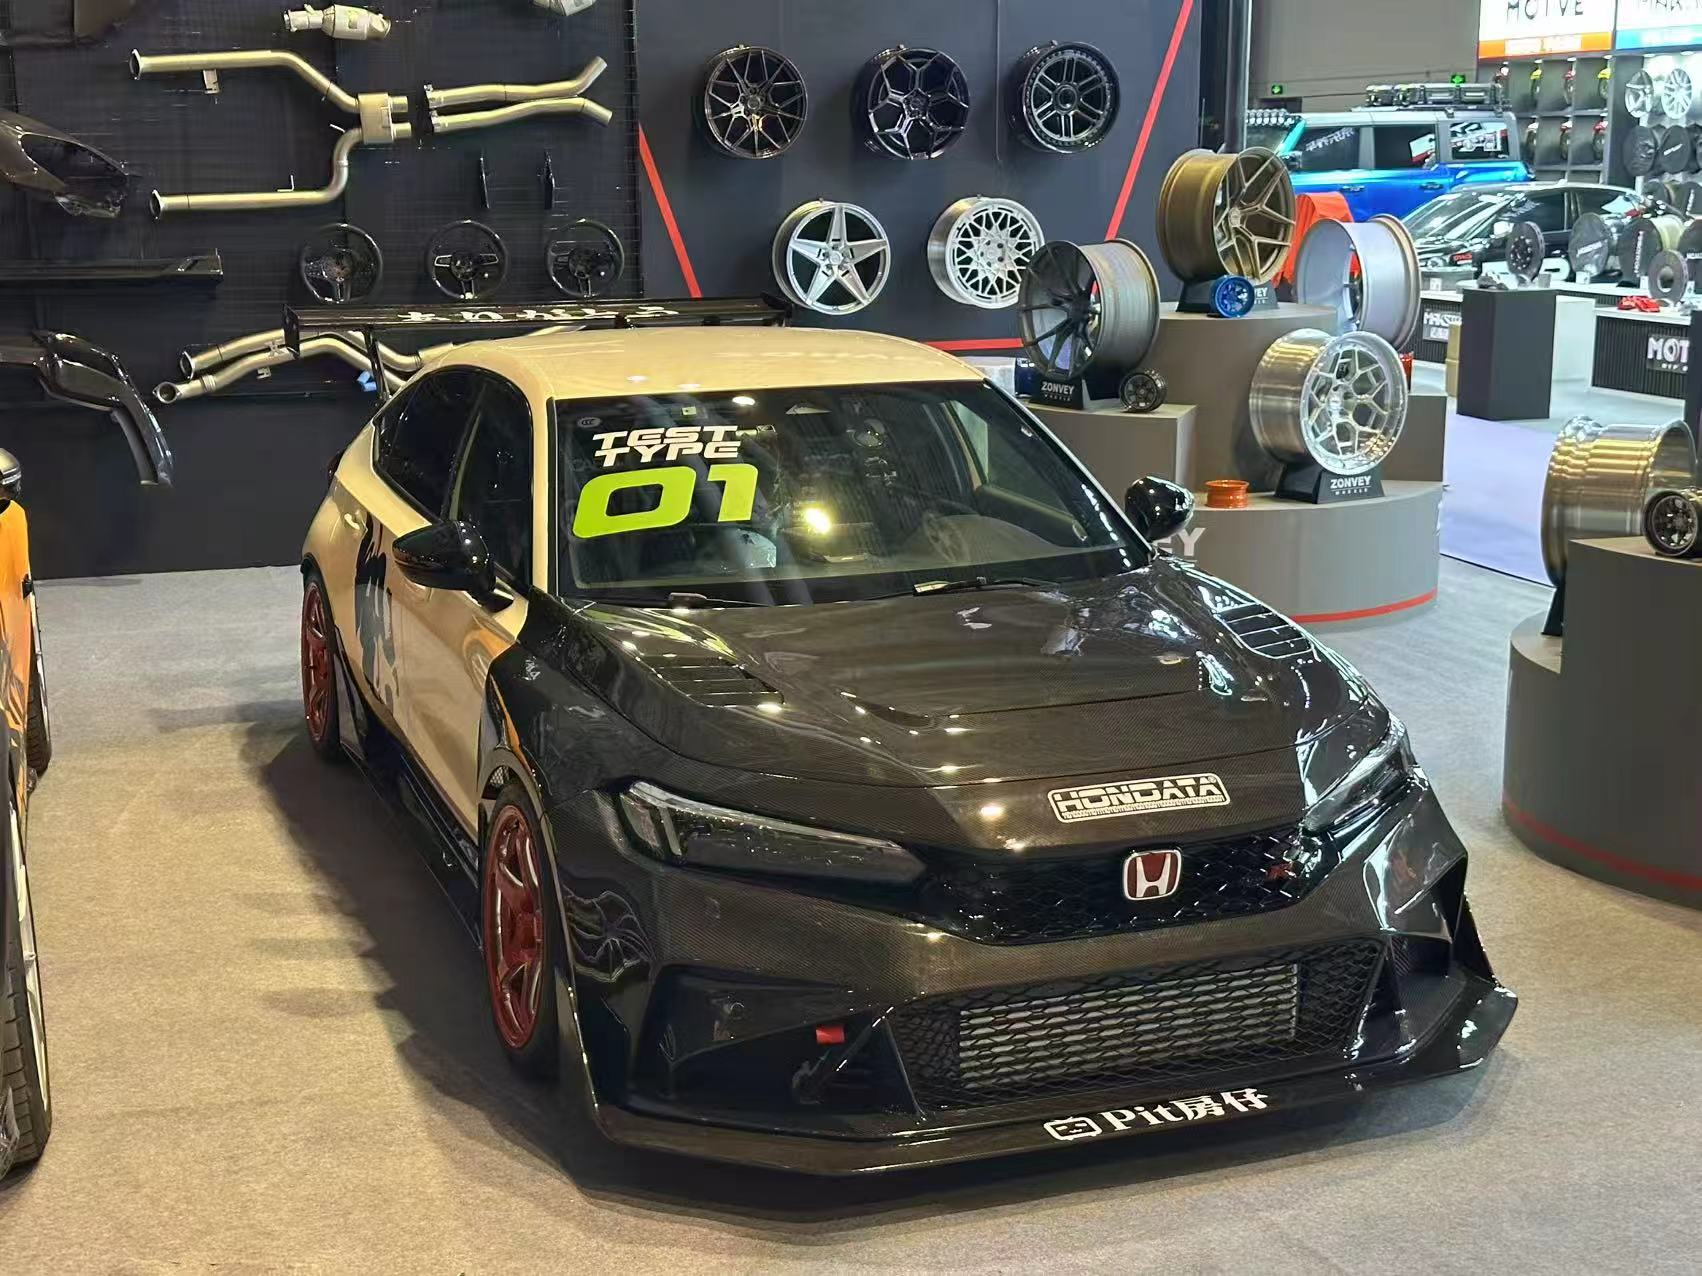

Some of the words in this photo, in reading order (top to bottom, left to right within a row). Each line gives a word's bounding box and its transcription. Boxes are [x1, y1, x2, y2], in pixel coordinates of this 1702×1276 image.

[1041, 381, 1075, 395] ZONVEY
[592, 425, 738, 450] TEST
[594, 441, 741, 467] TYPE
[1330, 475, 1371, 489] ZONVEY
[572, 463, 758, 538] 01
